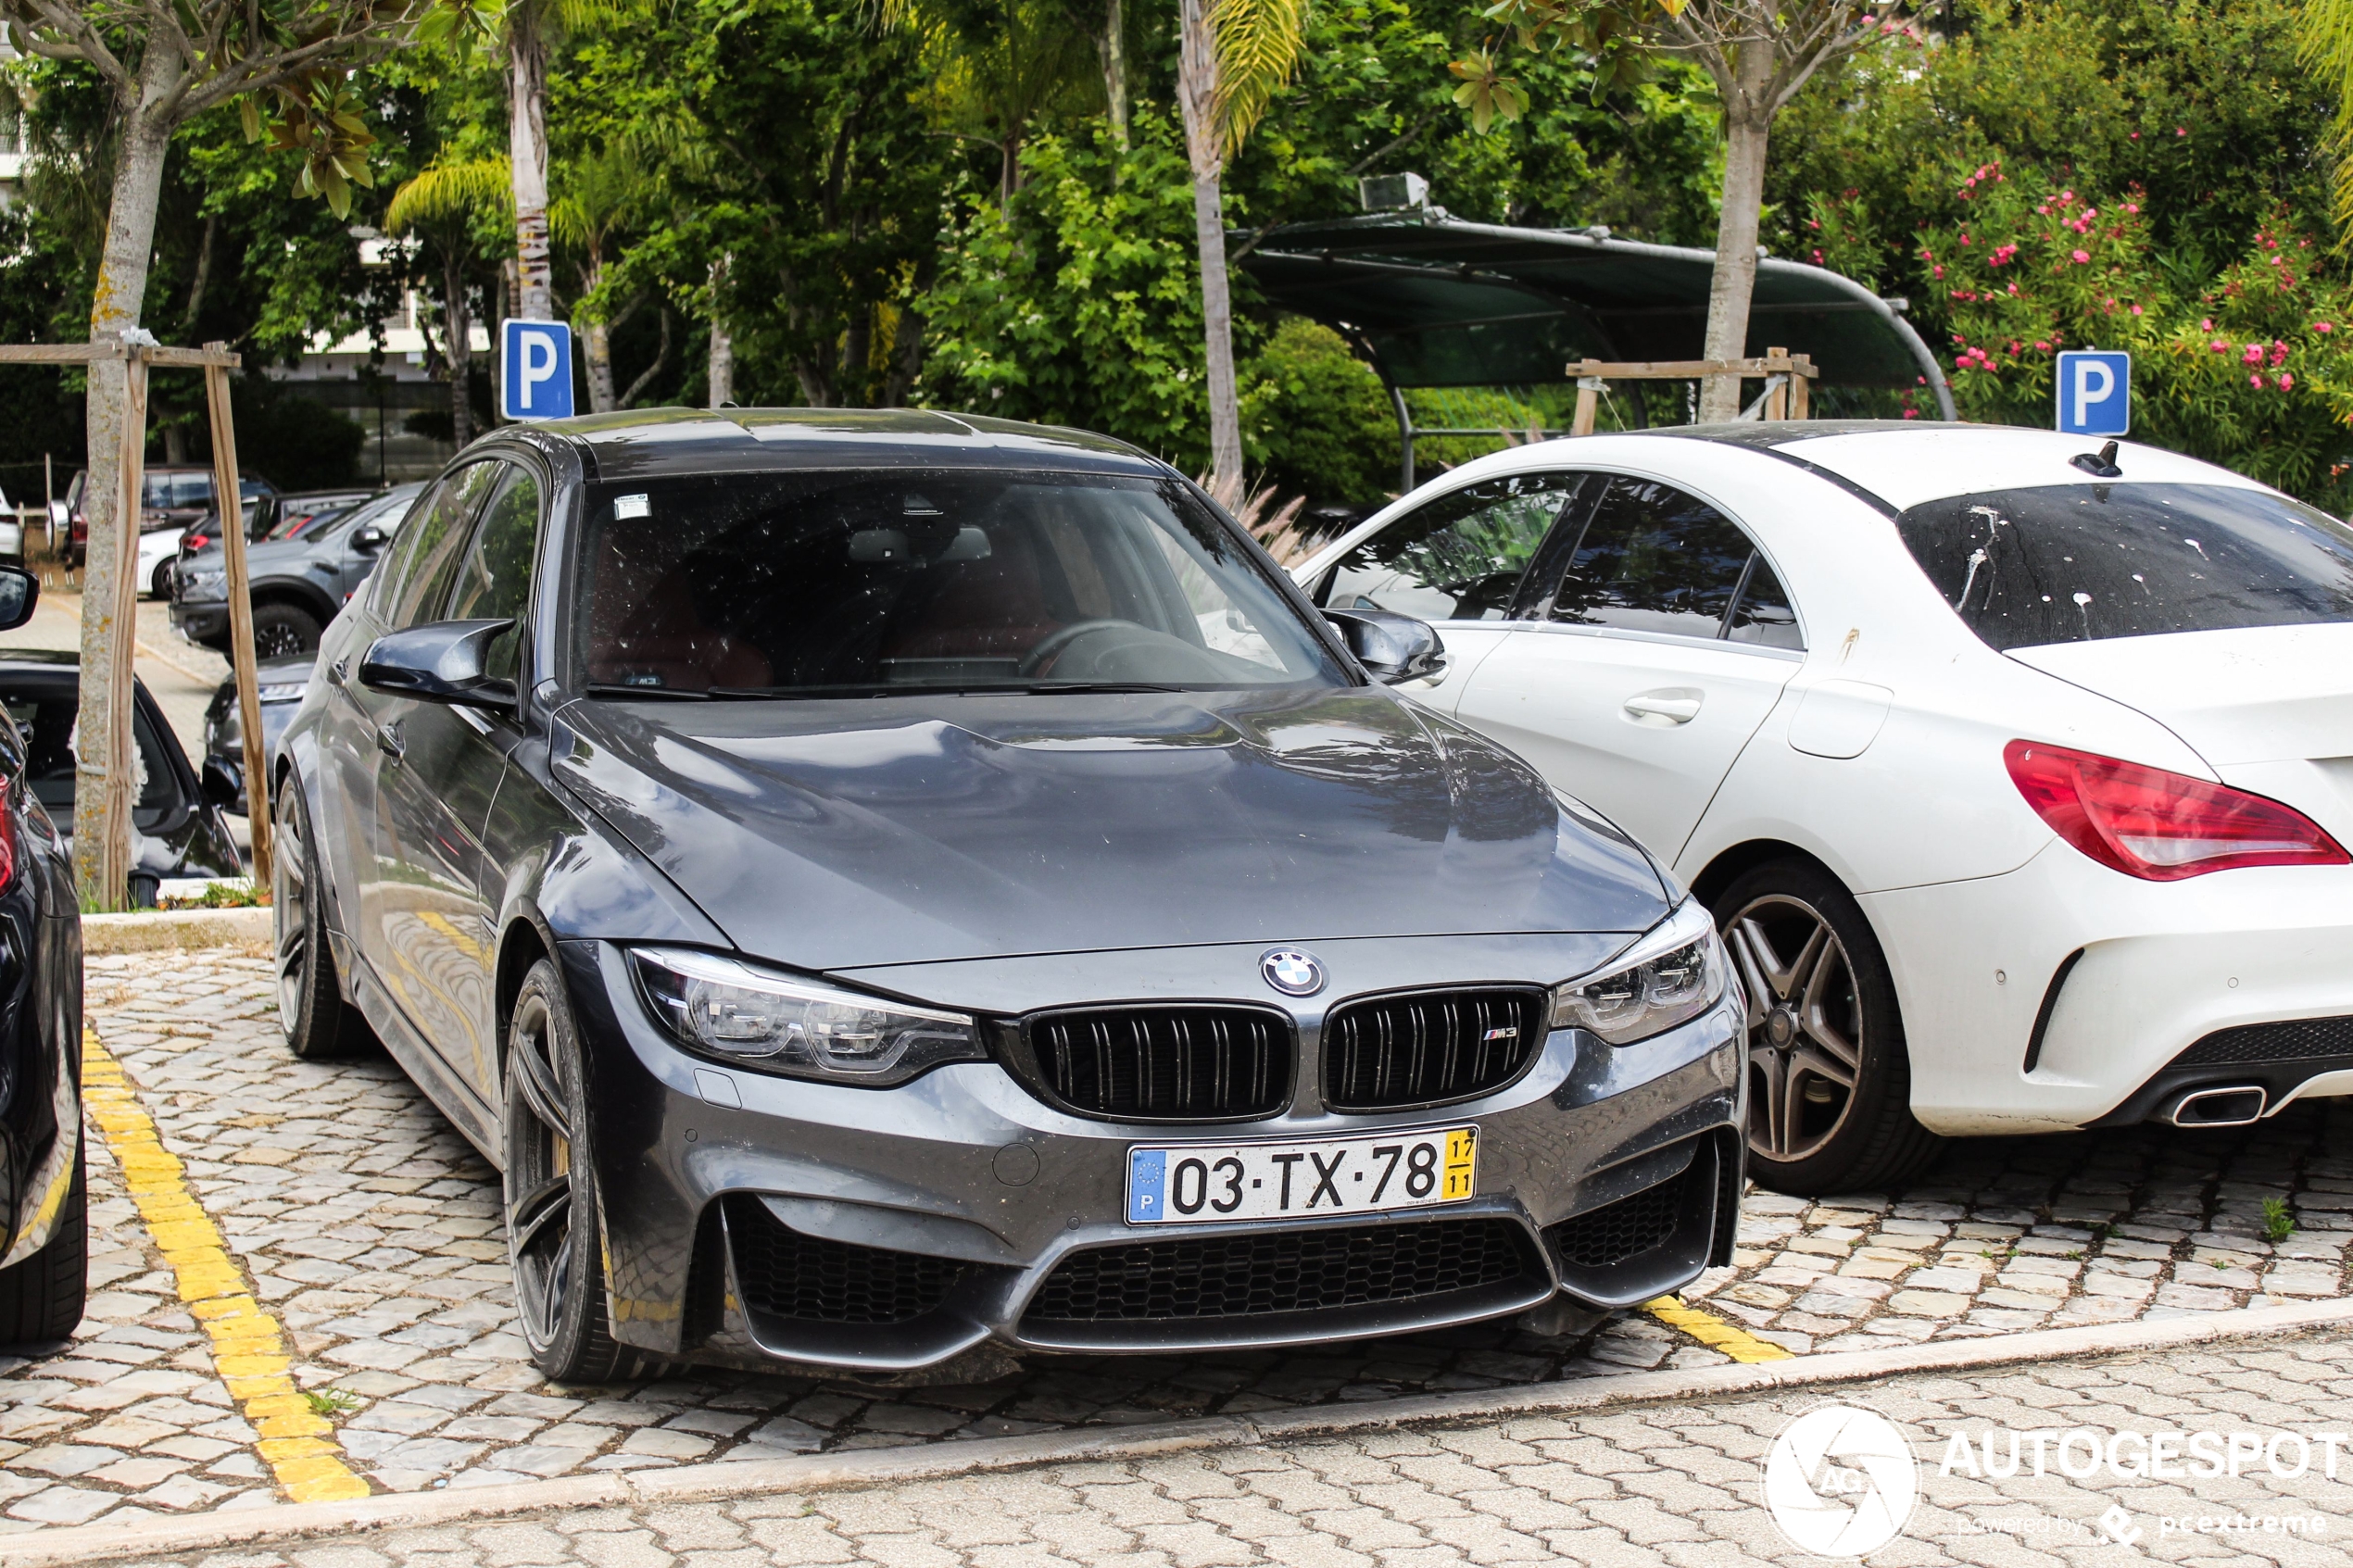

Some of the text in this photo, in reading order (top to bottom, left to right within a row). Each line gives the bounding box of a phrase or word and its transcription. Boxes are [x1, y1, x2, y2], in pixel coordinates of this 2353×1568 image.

[521, 330, 558, 409] P
[2074, 359, 2116, 427] P
[1453, 1138, 1474, 1158] 17
[1450, 1173, 1469, 1194] 11
[1140, 1194, 1154, 1210] P
